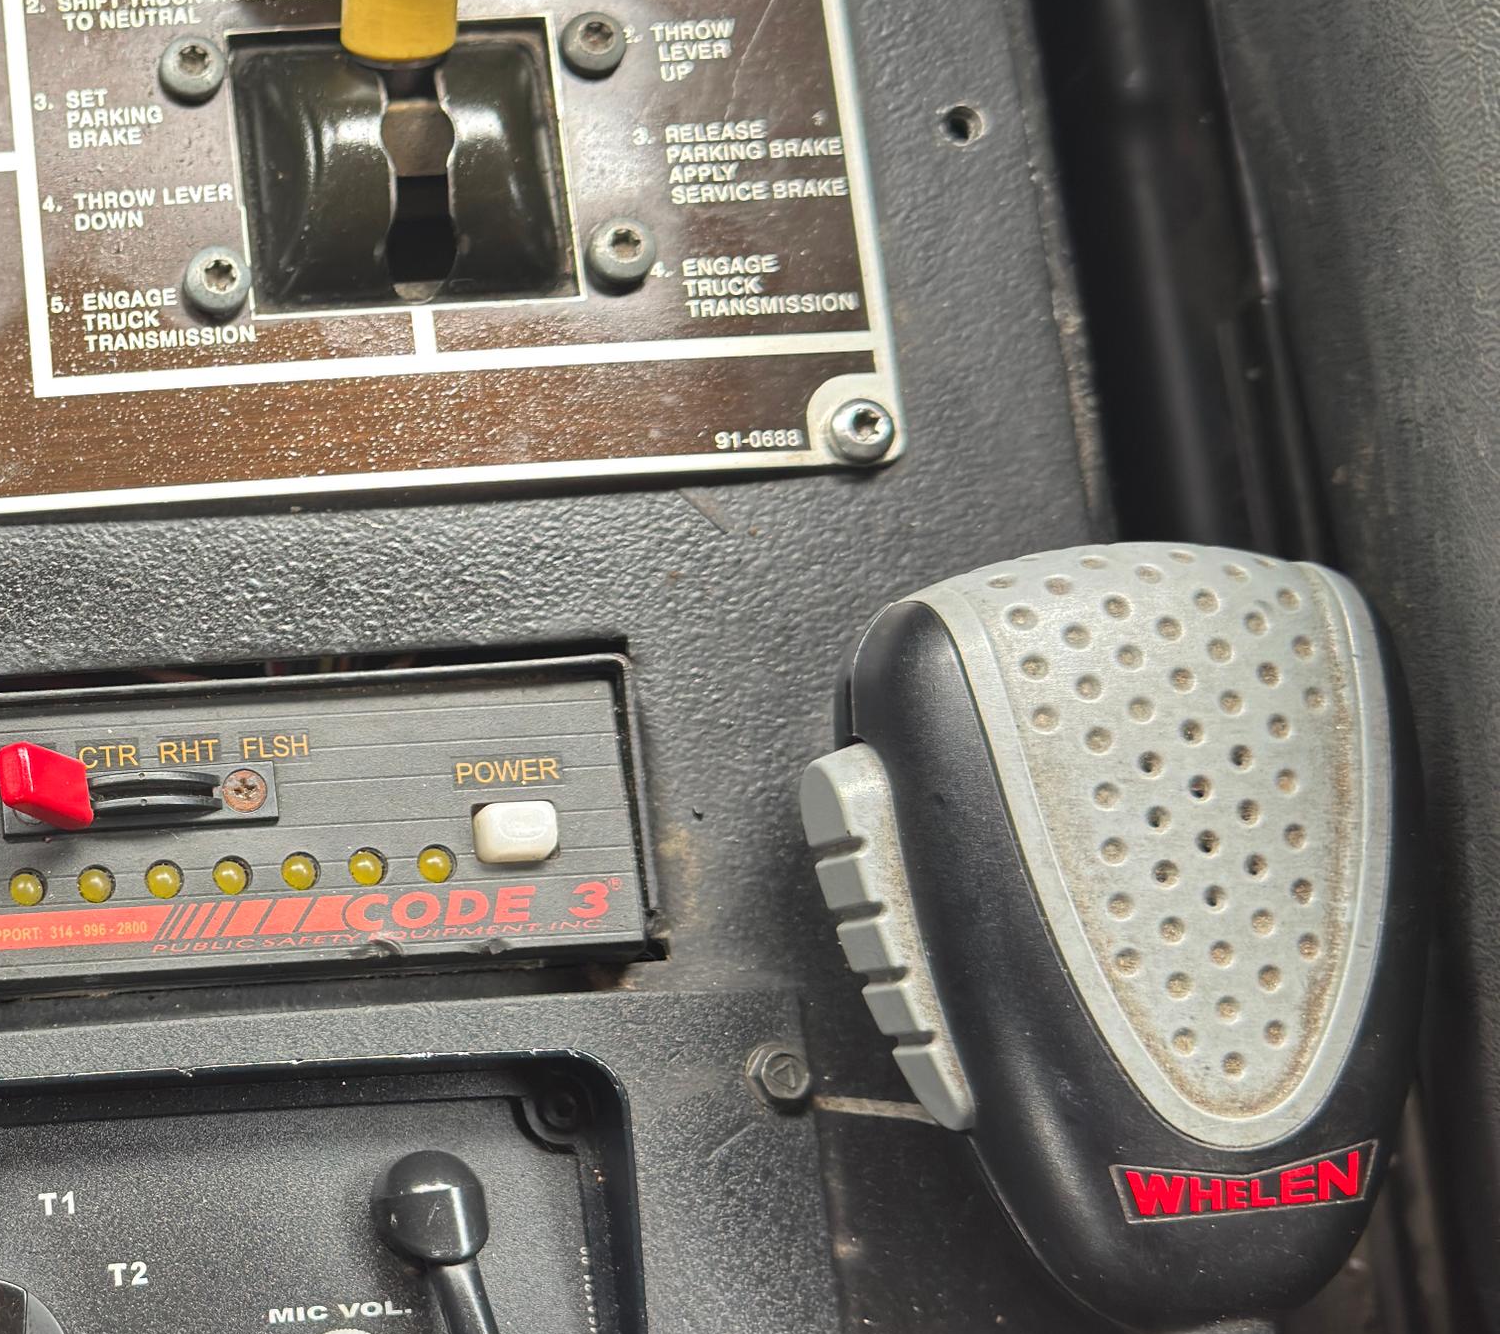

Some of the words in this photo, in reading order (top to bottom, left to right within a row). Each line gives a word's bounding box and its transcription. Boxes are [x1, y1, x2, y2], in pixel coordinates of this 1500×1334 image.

[62, 11, 95, 31] TO
[100, 7, 202, 30] NEUTRAL
[650, 18, 736, 41] THROW
[658, 38, 732, 63] LEVER
[660, 60, 696, 83] UP
[34, 93, 54, 111] 3.
[66, 88, 108, 108] SET
[66, 106, 164, 129] PARKING
[68, 127, 143, 149] BRAKE
[632, 128, 656, 146] 3.
[665, 119, 769, 144] RELEASE
[666, 141, 766, 164] PARKING
[769, 135, 843, 159] BRAKE
[669, 162, 739, 185] APPLY
[42, 195, 63, 213] 4.
[73, 189, 156, 211] THROW
[163, 183, 234, 206] LEVER
[671, 181, 770, 205] SERVICE
[773, 177, 849, 200] BRAKE
[74, 211, 144, 232] DOWN
[650, 261, 674, 279] 4.
[682, 254, 781, 277] ENGAGE
[682, 275, 764, 298] TRUCK
[51, 296, 71, 314] 5.
[83, 288, 178, 312] ENGAGE
[685, 291, 860, 318] TRANSMISSION
[83, 309, 160, 331] TRUCK
[84, 324, 257, 353] TRANSMISSION
[714, 428, 805, 451] 91-0688
[79, 744, 140, 770] CTR
[157, 738, 220, 765] RHT
[242, 734, 310, 760] FLSH
[455, 757, 561, 785] POWER
[343, 885, 537, 933] CODE
[151, 937, 255, 953] PUBLIC
[261, 932, 361, 948] SAFETY
[1125, 1150, 1360, 1216] WHELEN
[38, 1190, 76, 1216] T1
[107, 1261, 149, 1287] T2
[269, 1304, 328, 1324] MIC
[337, 1299, 413, 1319] VOL.
